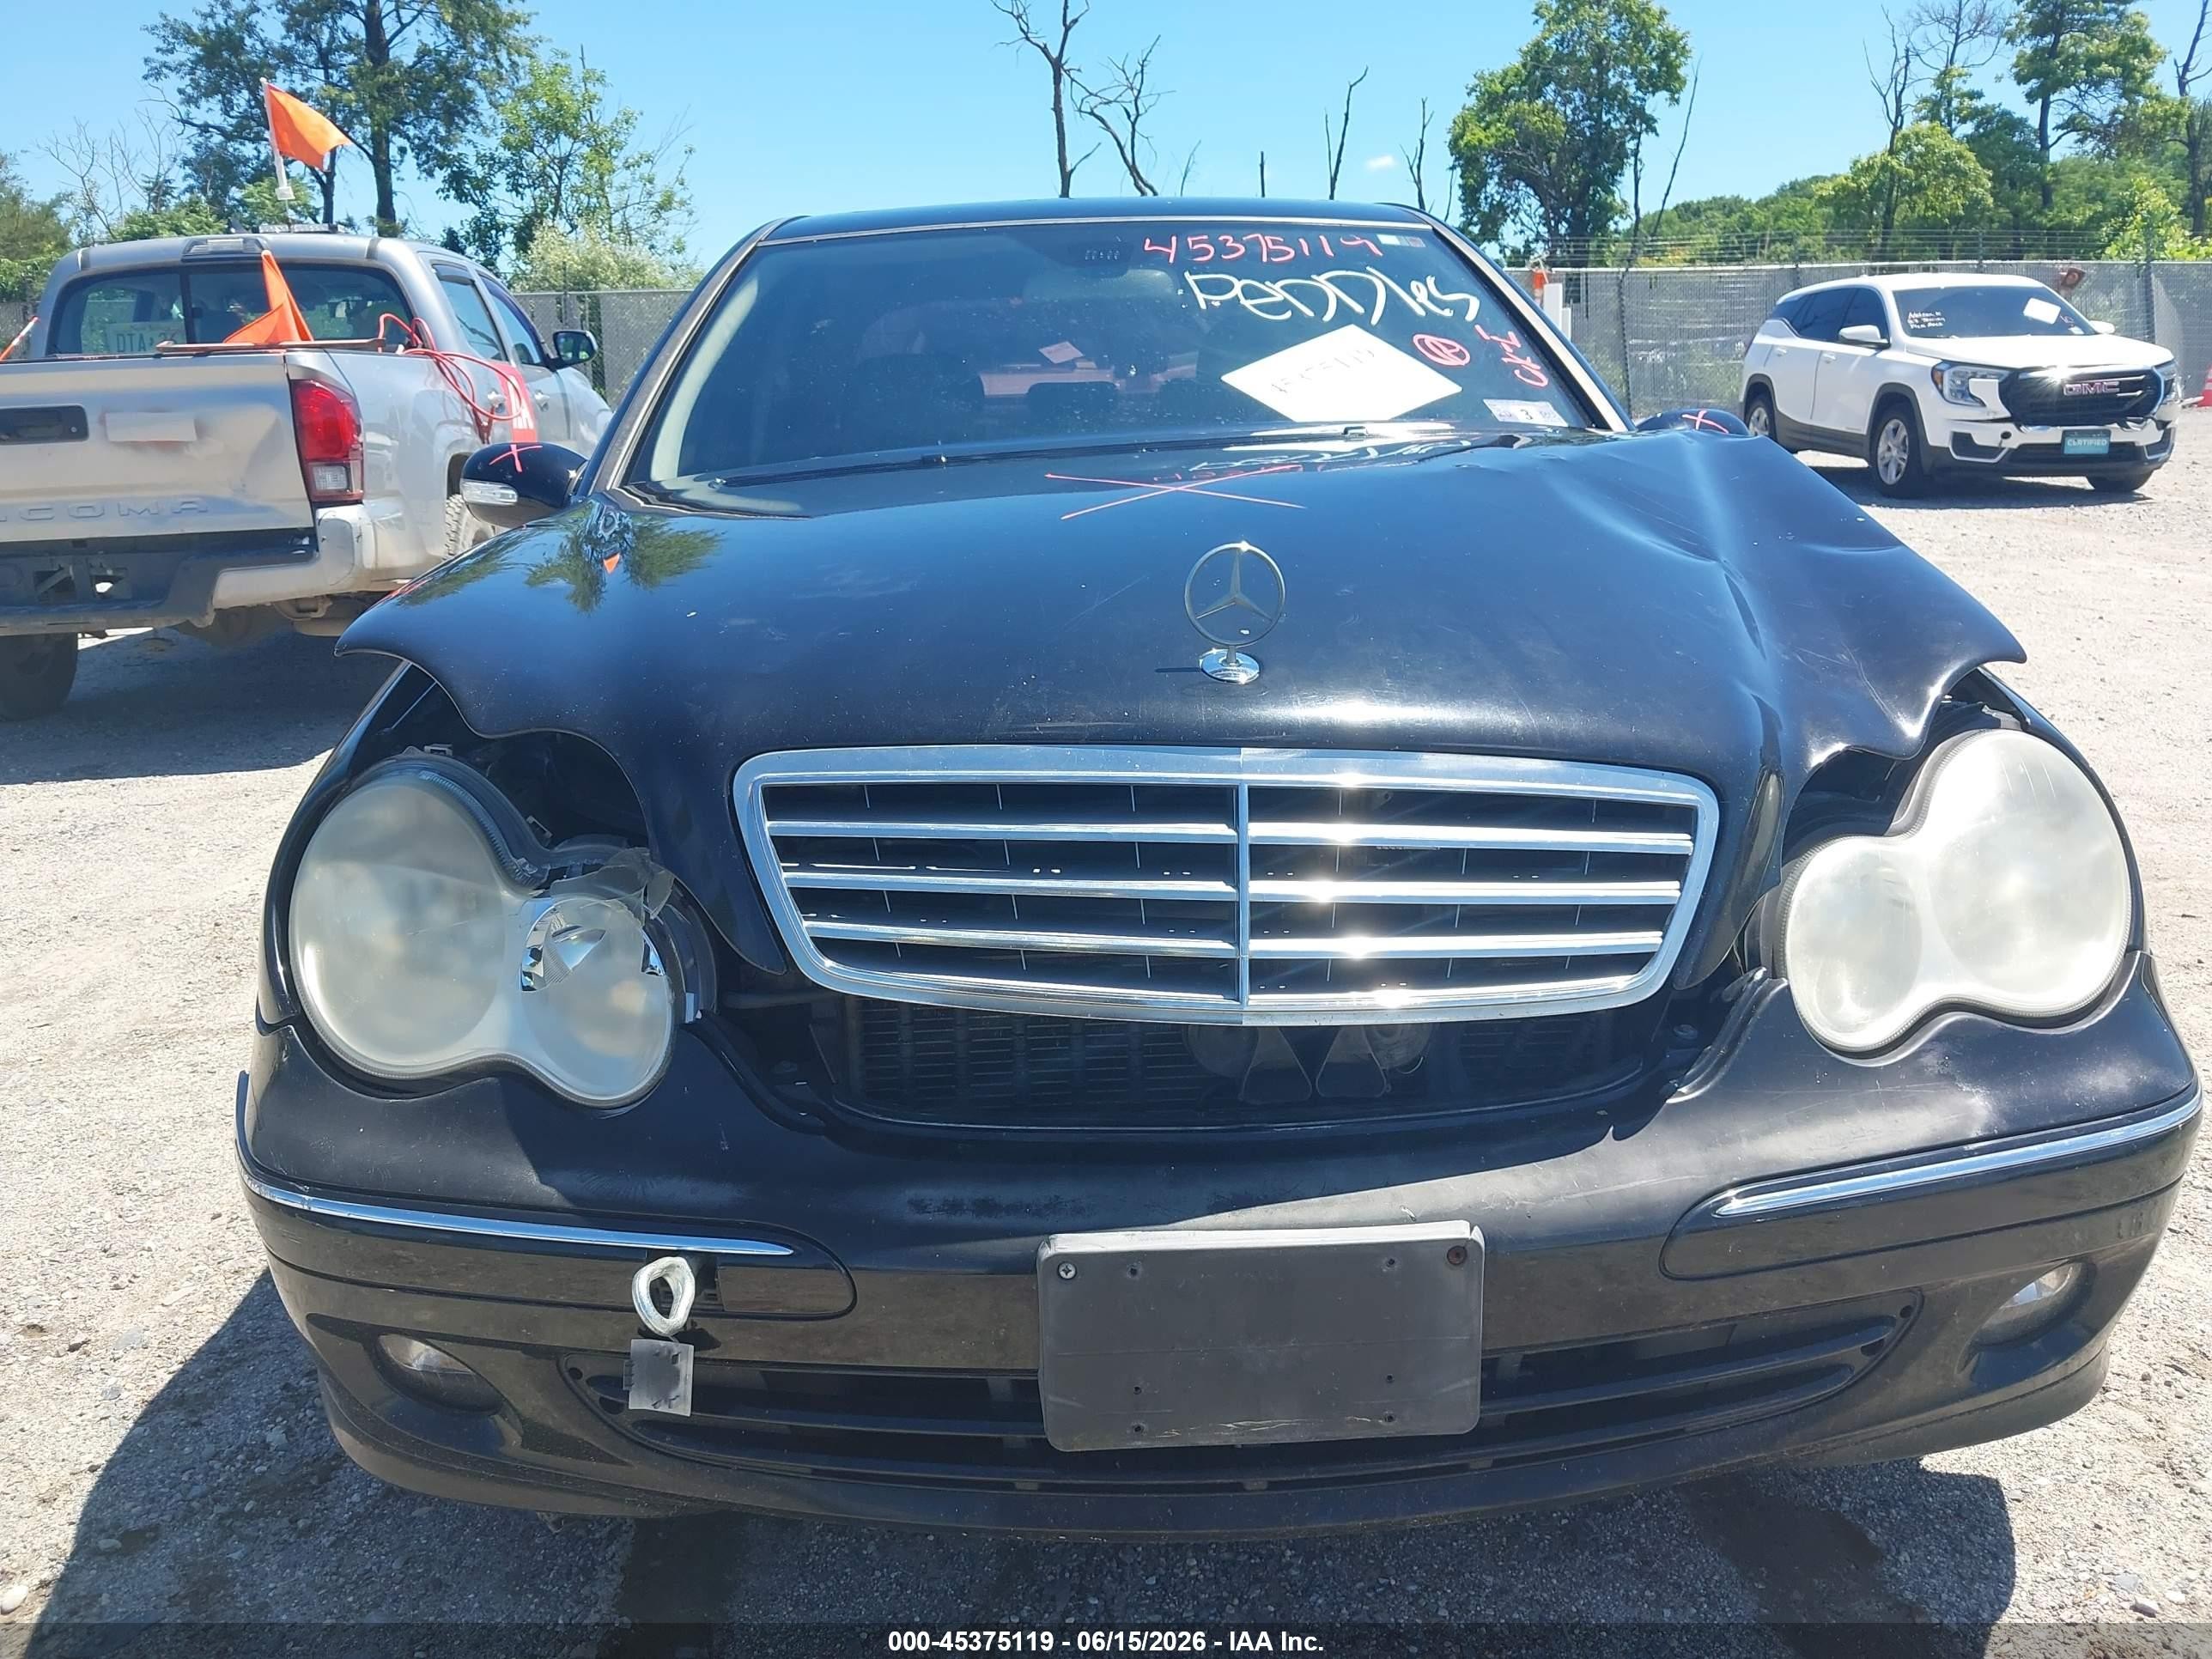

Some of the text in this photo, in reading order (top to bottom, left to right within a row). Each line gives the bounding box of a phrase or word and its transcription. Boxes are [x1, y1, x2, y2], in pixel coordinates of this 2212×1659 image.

[2063, 381, 2120, 396] GMC
[2067, 438, 2107, 447] CERTIFIED
[0, 500, 209, 523] COMA
